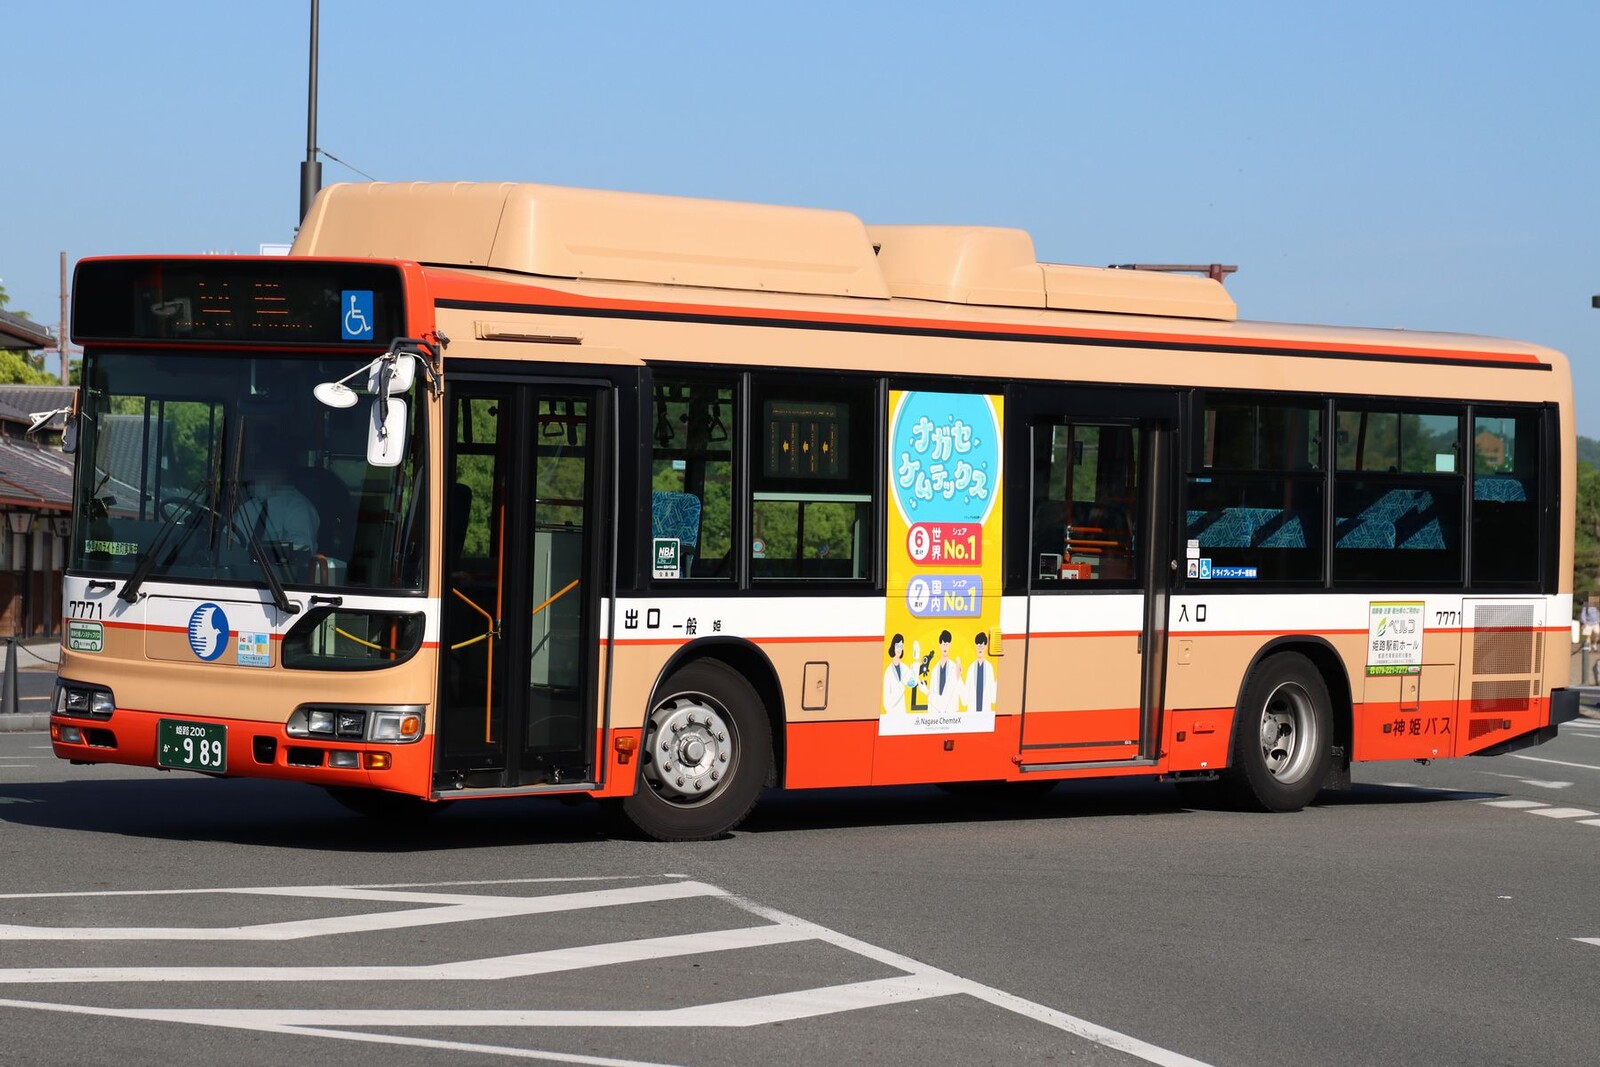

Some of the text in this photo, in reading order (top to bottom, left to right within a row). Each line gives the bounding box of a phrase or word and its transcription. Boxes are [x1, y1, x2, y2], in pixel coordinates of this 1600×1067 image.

[912, 416, 972, 461] ナガセ
[898, 452, 988, 500] ケムテックス
[915, 530, 924, 548] 6
[952, 527, 967, 536] シェア
[659, 546, 675, 558] NBA
[931, 527, 942, 560] 世界
[944, 534, 976, 561] No.1
[1212, 568, 1257, 577] ドライブレコーダー
[915, 583, 923, 600] 7
[952, 579, 968, 588] シェア
[930, 579, 942, 613] 国内
[943, 586, 976, 612] No.1
[69, 600, 103, 620] 7771
[624, 608, 661, 630] 出口
[1178, 604, 1207, 622] 入口
[1435, 611, 1462, 626] 7771
[672, 617, 698, 635] 一般
[1388, 618, 1416, 634] ベルコ
[1372, 640, 1420, 652] 姫路駅前ホール
[921, 716, 961, 726] Nagase ChemteX
[1393, 717, 1451, 737] 神姫バス
[175, 725, 206, 737] 姫路200
[183, 737, 222, 767] 989
